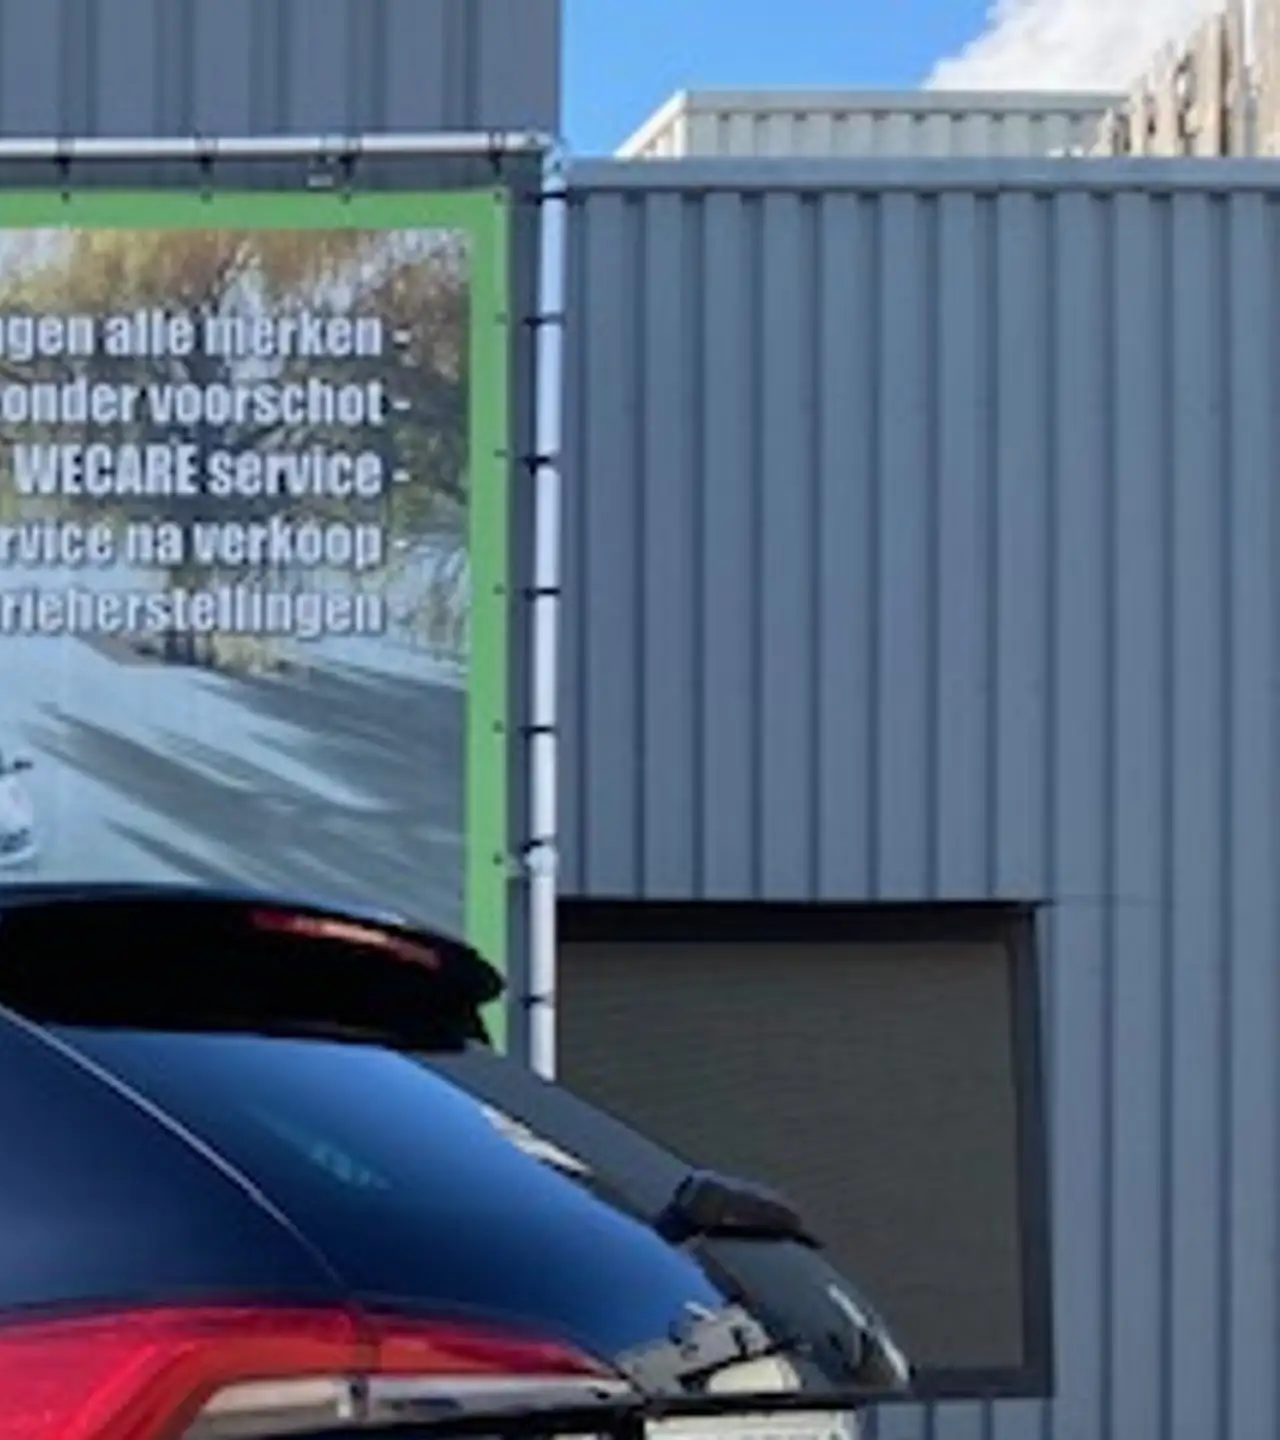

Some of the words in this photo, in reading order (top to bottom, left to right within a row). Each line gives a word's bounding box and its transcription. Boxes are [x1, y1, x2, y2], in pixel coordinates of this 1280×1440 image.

[105, 308, 192, 356] alle
[204, 310, 383, 357] merken
[146, 378, 385, 425] voorschot
[13, 443, 199, 497] WECARE
[207, 445, 383, 497] service
[126, 529, 184, 566] na
[193, 520, 383, 568] verkoop
